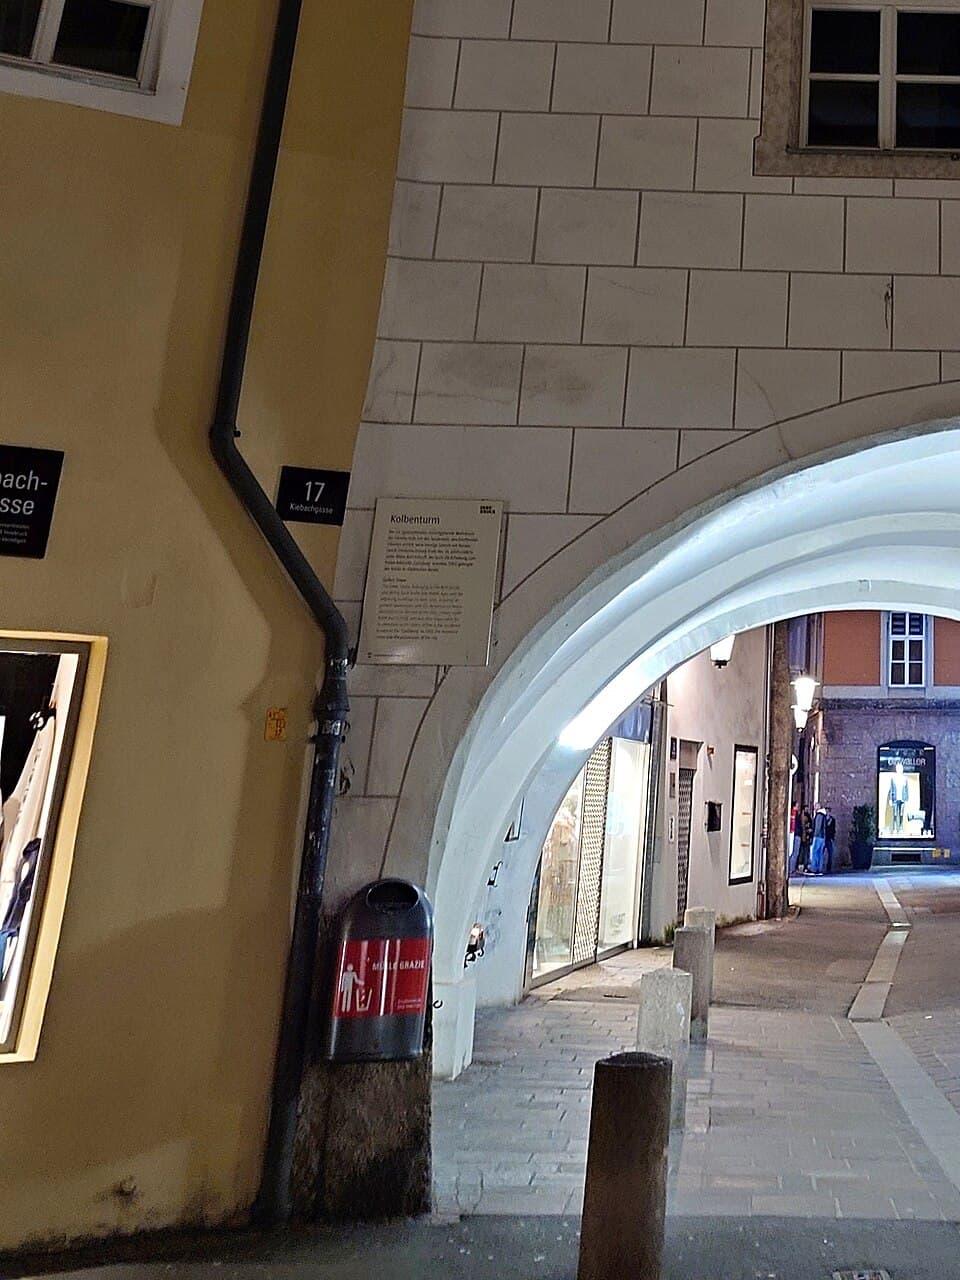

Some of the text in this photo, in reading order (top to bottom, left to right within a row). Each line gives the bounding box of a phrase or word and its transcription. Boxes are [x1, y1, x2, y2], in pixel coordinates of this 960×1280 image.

[0, 469, 48, 491] ach-
[305, 480, 326, 502] 17
[289, 502, 334, 515] Kiebachgasse
[390, 514, 440, 525] Kolbenturm
[372, 959, 425, 971] MILE GRAZIE
